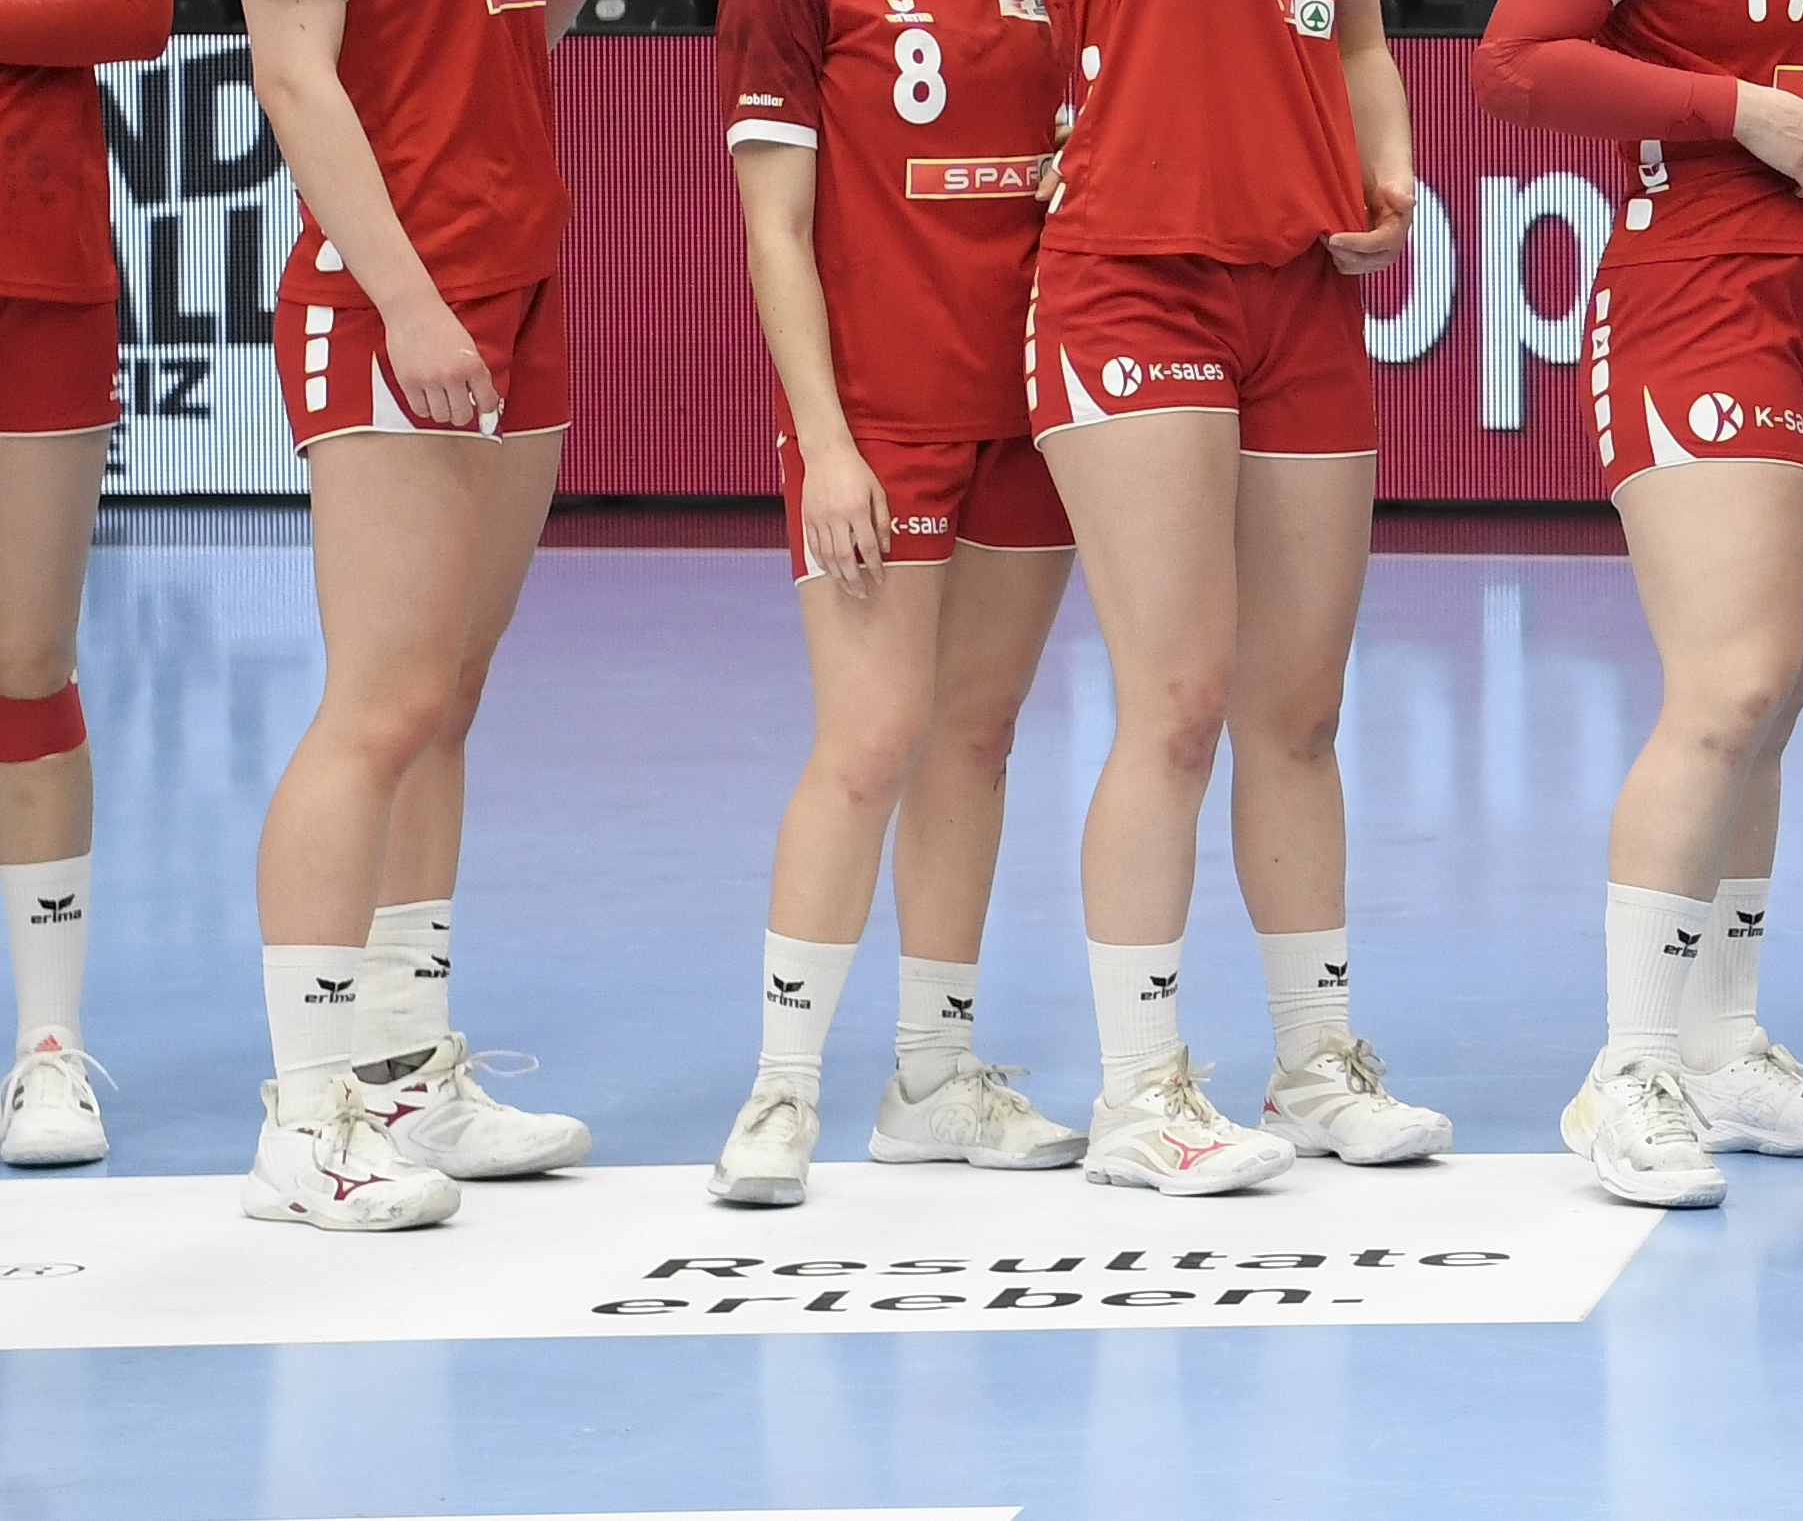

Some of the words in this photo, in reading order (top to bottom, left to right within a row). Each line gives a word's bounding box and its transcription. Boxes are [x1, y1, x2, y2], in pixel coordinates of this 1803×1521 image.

[892, 27, 949, 126] 8
[30, 908, 83, 925] erima
[304, 991, 357, 1004] erima
[766, 990, 812, 1010] erima
[642, 1246, 1512, 1281] Resultate
[589, 1286, 1365, 1317] erleben.
